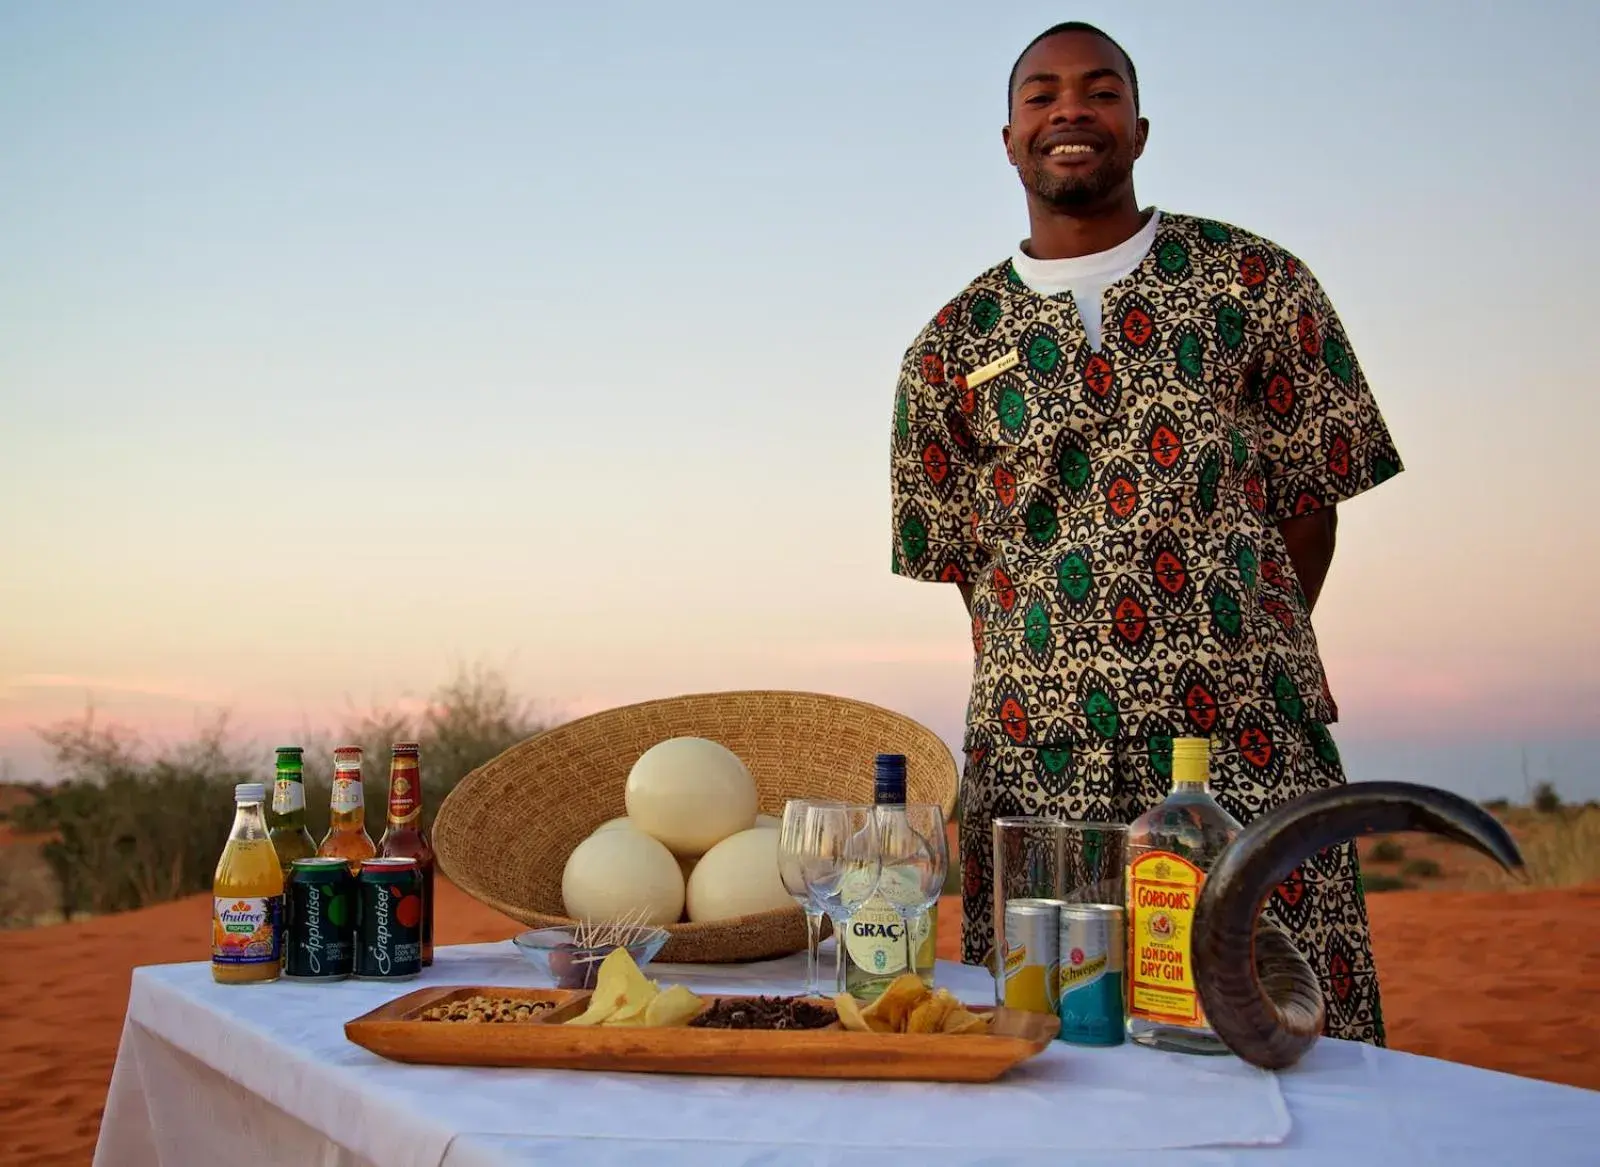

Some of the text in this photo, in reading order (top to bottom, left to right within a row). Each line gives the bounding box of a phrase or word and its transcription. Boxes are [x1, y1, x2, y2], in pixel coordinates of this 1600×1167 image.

[1138, 886, 1191, 910] GORDON'S
[220, 909, 263, 922] fruitree
[301, 885, 324, 974] Appletiser
[369, 885, 392, 975] Grapetiser
[1141, 946, 1183, 964] LONDON
[1140, 960, 1184, 981] DRY GIN
